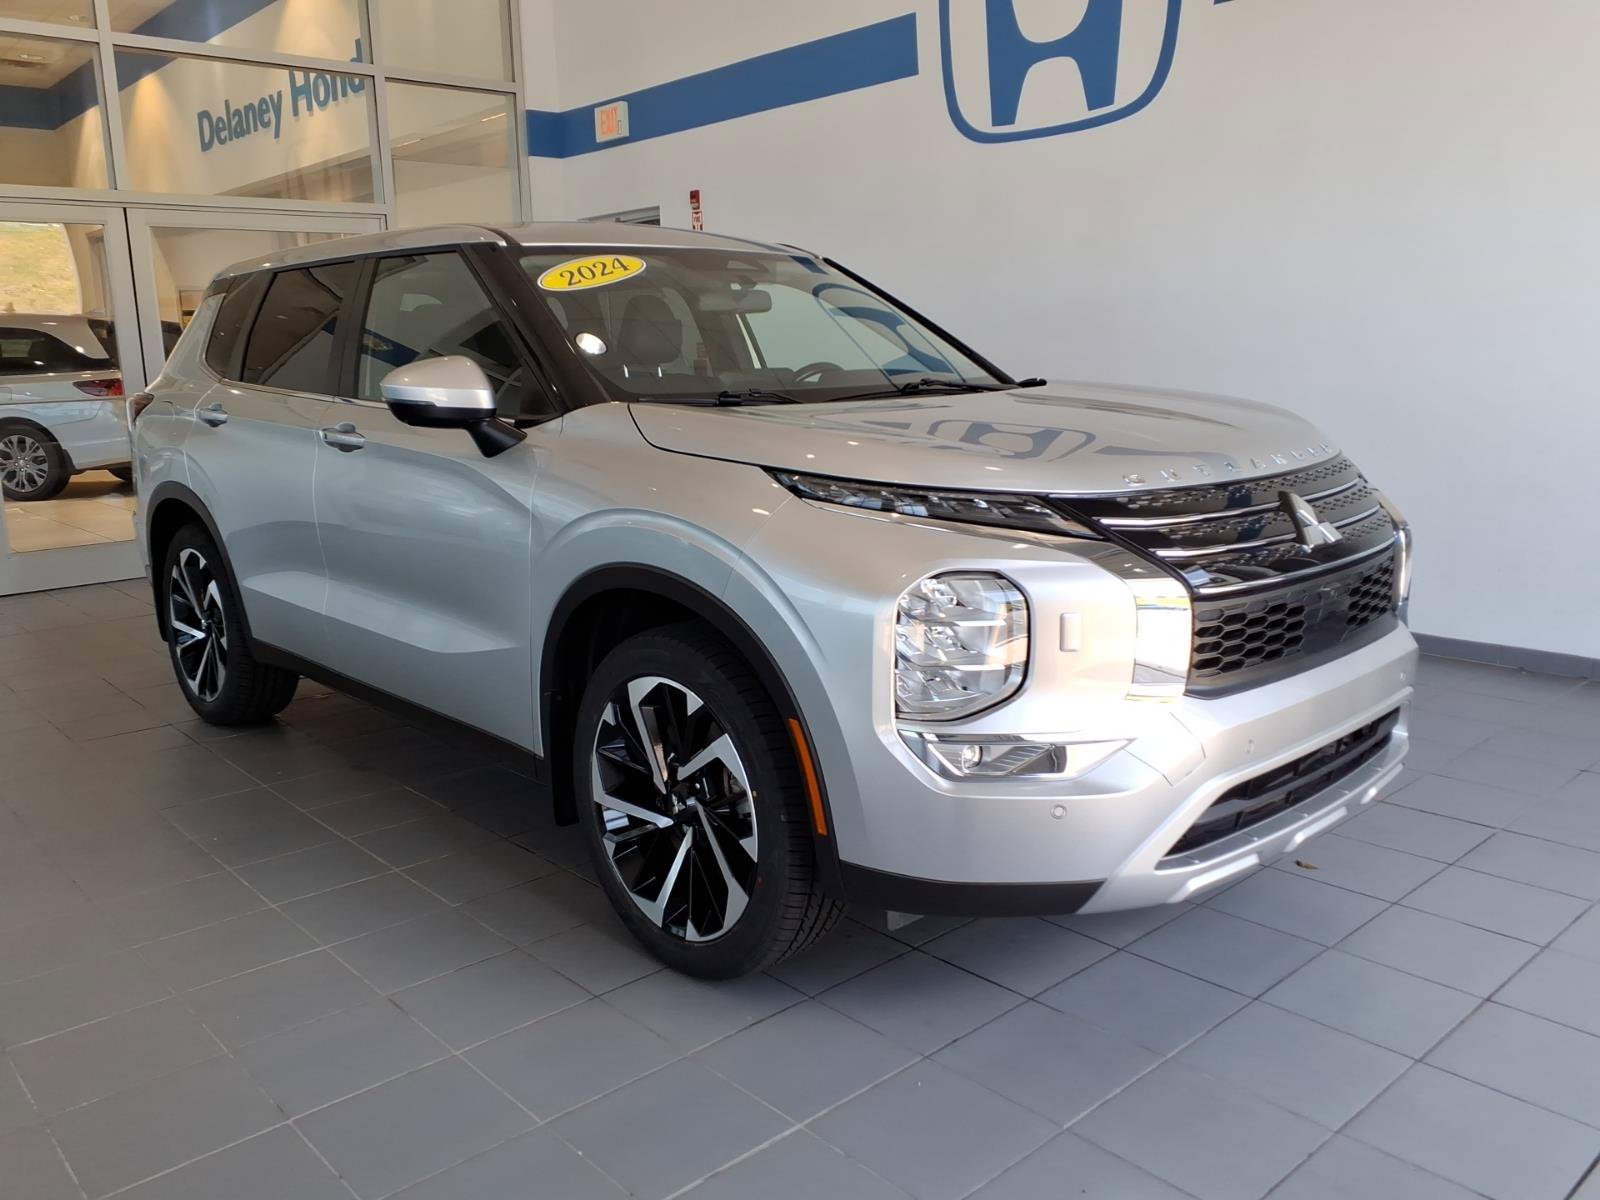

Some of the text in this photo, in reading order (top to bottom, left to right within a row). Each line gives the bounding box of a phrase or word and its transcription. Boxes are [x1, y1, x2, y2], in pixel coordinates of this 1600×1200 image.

[196, 89, 283, 152] Delaney
[599, 106, 618, 136] EXIT
[559, 257, 630, 287] 2024
